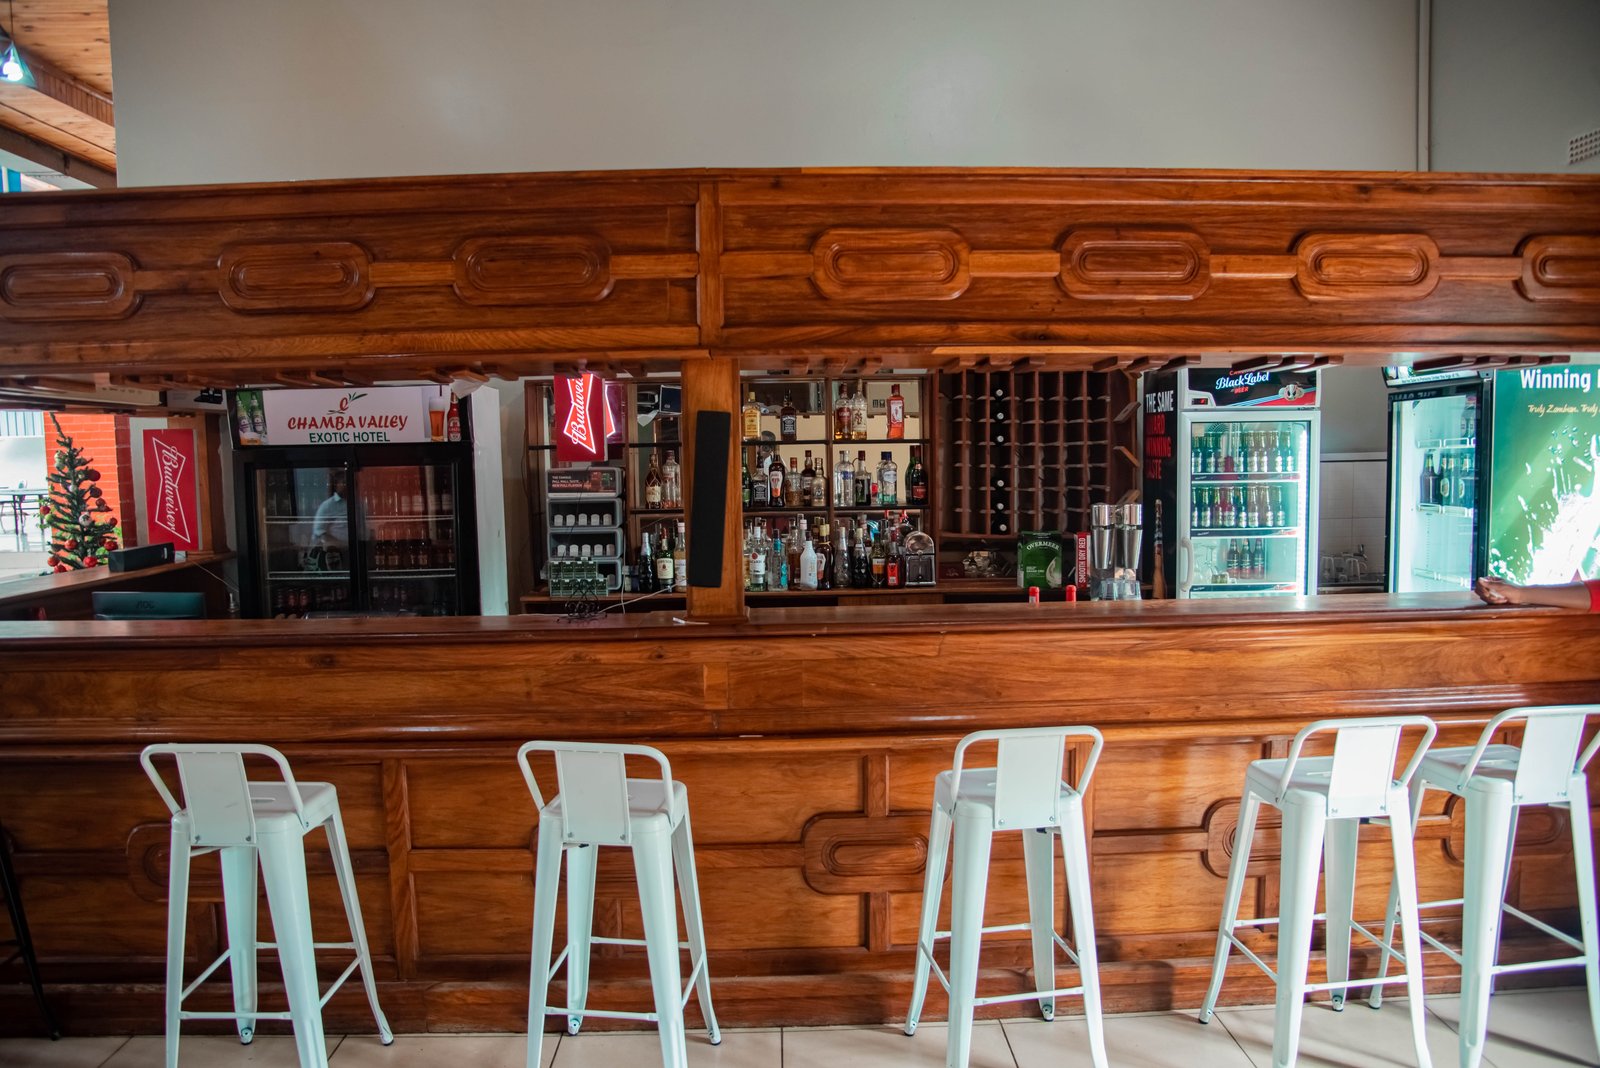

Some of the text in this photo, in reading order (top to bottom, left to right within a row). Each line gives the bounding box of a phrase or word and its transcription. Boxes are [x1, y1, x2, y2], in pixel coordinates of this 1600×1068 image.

[1215, 375, 1245, 390] Black
[1244, 371, 1270, 386] Label
[1520, 368, 1591, 393] Winning
[571, 376, 587, 444] Budwei
[1146, 390, 1174, 413] THE SAME
[1527, 403, 1546, 418] Truly
[1580, 403, 1599, 418] Truly
[287, 414, 408, 431] CHAMBA VALLEY
[309, 432, 390, 443] EXOTIC HOTEL
[161, 445, 179, 532] Budweiser
[1026, 541, 1060, 551] OVERMEER
[1078, 537, 1086, 583] SMOOTH DRY RED
